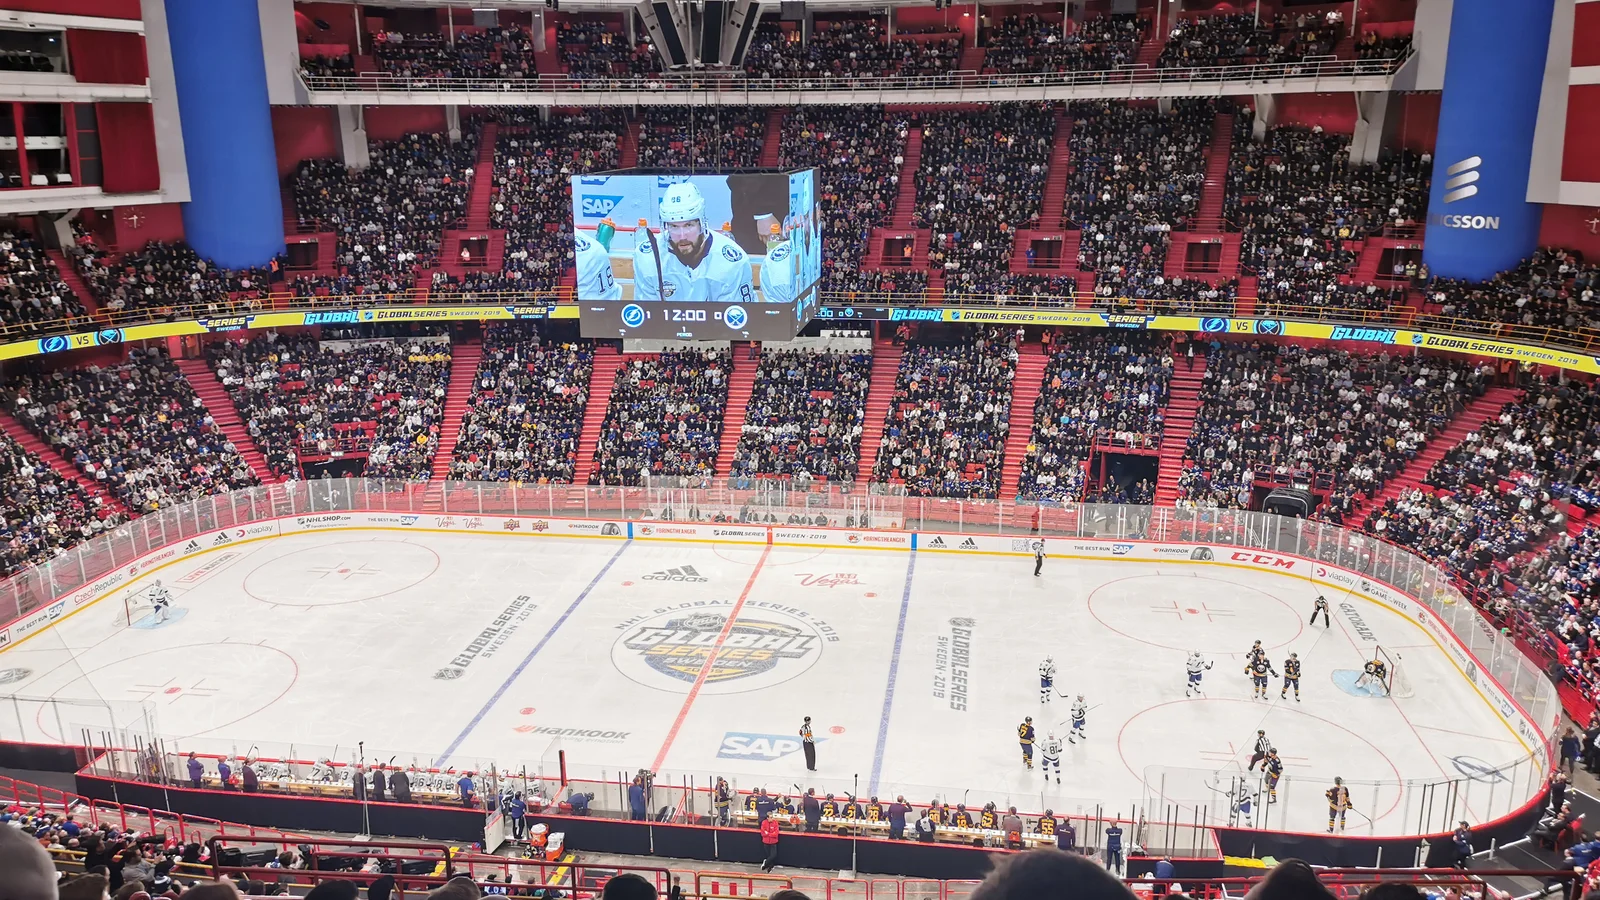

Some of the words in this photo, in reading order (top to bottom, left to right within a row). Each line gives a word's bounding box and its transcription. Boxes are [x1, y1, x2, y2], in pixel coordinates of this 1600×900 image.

[583, 198, 614, 214] SAP
[304, 310, 360, 325] GLOBAL
[512, 306, 548, 315] SERIES
[646, 311, 651, 319] 1
[663, 309, 707, 321] 12:00
[891, 308, 944, 322] GLOBAL
[206, 317, 246, 328] SERIES
[1107, 314, 1146, 324] SERIES
[1236, 322, 1248, 331] VS
[76, 336, 90, 346] VS
[1330, 326, 1397, 344] GLOBAL
[1516, 349, 1554, 360] SWEDEN
[1557, 355, 1579, 365] 2019
[401, 516, 415, 525] SAP
[435, 517, 456, 528] Vegas
[462, 518, 484, 529] Vegas
[246, 524, 273, 535] viaplay
[212, 537, 232, 547] adidas
[184, 545, 202, 555] adidas
[1113, 545, 1130, 554] SAP
[1230, 551, 1296, 570] CCM
[641, 573, 709, 583] adidas
[794, 573, 867, 589] Vegas
[1327, 571, 1355, 586] viaplay
[1370, 589, 1388, 600] GAME
[1393, 599, 1408, 611] WEEK
[49, 604, 63, 618] SAP
[16, 625, 26, 634] THE
[26, 619, 38, 629] BEST
[38, 614, 48, 622] RUN
[614, 615, 649, 630] NHL
[653, 599, 734, 614] GLOBAL
[745, 600, 810, 618] SERIES
[812, 620, 840, 642] 2019
[1339, 602, 1378, 642] GATORADE
[481, 624, 518, 659] SWEDEN
[516, 603, 538, 622] 2019
[624, 627, 818, 656] GLOBAL
[646, 645, 772, 661] SERIES
[935, 635, 949, 672] SWEDEN
[933, 675, 946, 699] 2019
[720, 736, 801, 757] SAP
[1049, 745, 1058, 755] 81
[527, 786, 540, 796] 35
[1041, 822, 1054, 835] 55
